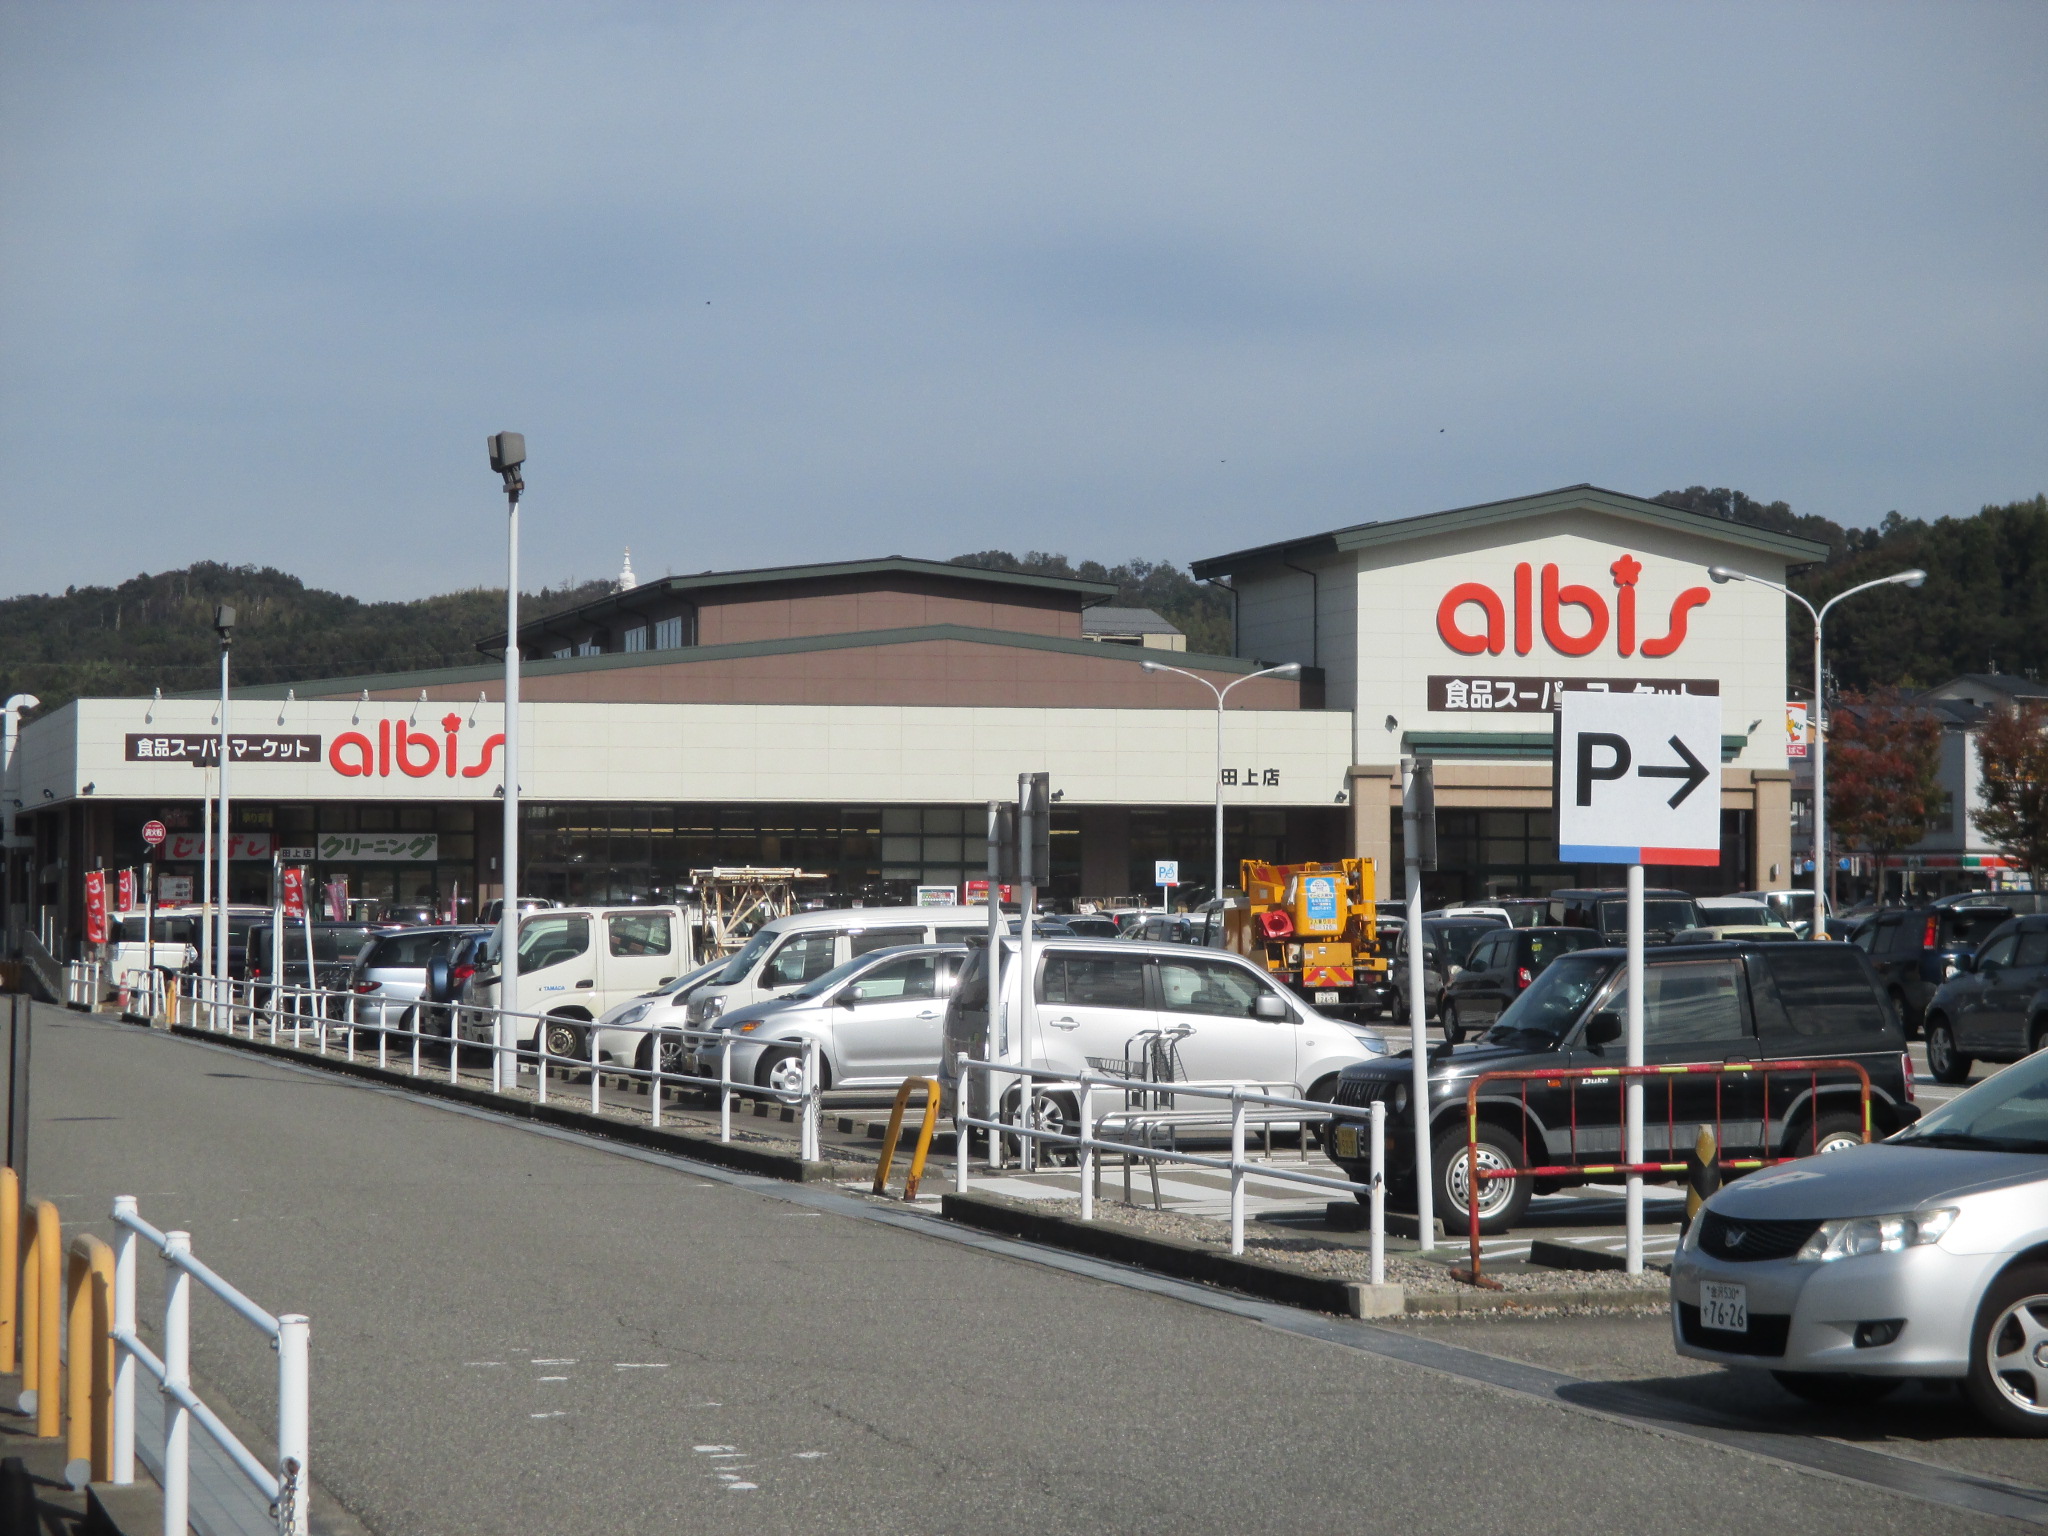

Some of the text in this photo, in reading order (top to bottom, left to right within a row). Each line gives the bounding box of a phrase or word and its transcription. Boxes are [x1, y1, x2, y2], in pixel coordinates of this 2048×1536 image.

[1437, 554, 1711, 658] albis
[137, 737, 310, 758] 食品スーパーマーケット
[329, 713, 506, 778] albis
[1786, 746, 1804, 755] ばこ
[1221, 768, 1280, 786] 田上店
[1576, 731, 1632, 807] P
[320, 836, 437, 859] クリーニング
[1581, 1077, 1609, 1085] Duke
